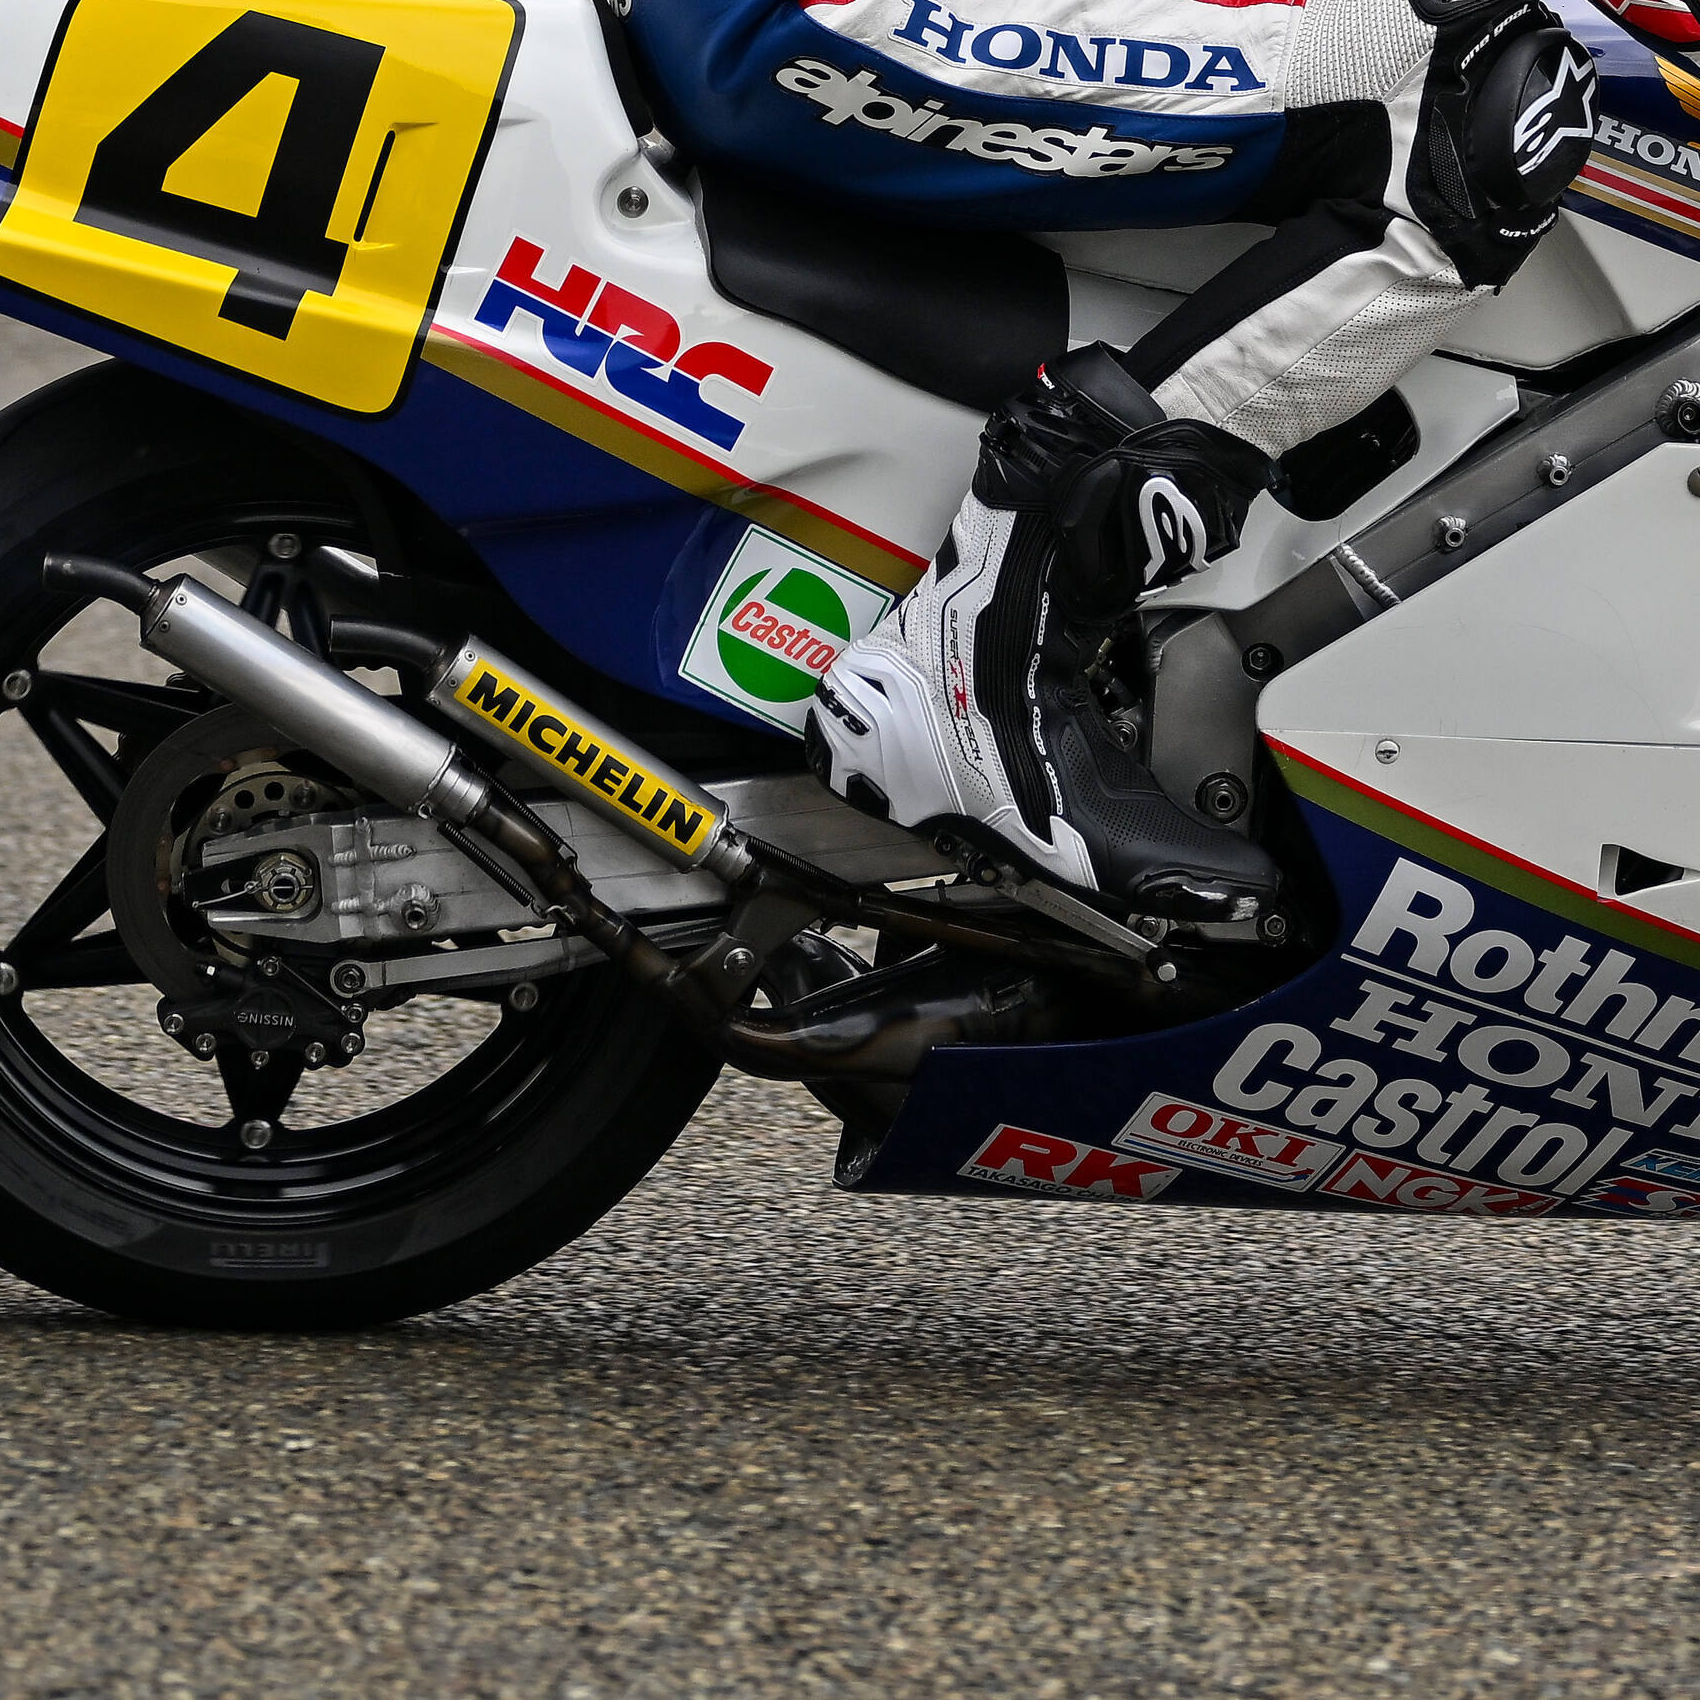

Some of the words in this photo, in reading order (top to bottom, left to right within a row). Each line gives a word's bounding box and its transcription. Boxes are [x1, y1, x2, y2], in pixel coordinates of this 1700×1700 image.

[72, 8, 386, 341] 4
[773, 56, 1234, 177] alpinestars
[473, 235, 775, 453] HRC
[949, 608, 960, 661] SUPER
[961, 710, 984, 762] TECH
[468, 670, 702, 847] MICHELIN
[249, 1013, 294, 1027] NISSIN
[972, 1125, 1177, 1198] RK
[1149, 1102, 1317, 1168] OKI
[1212, 1022, 1635, 1196] Castrol
[967, 1165, 1073, 1195] TAKASAGO
[1330, 1156, 1521, 1217] NGK
